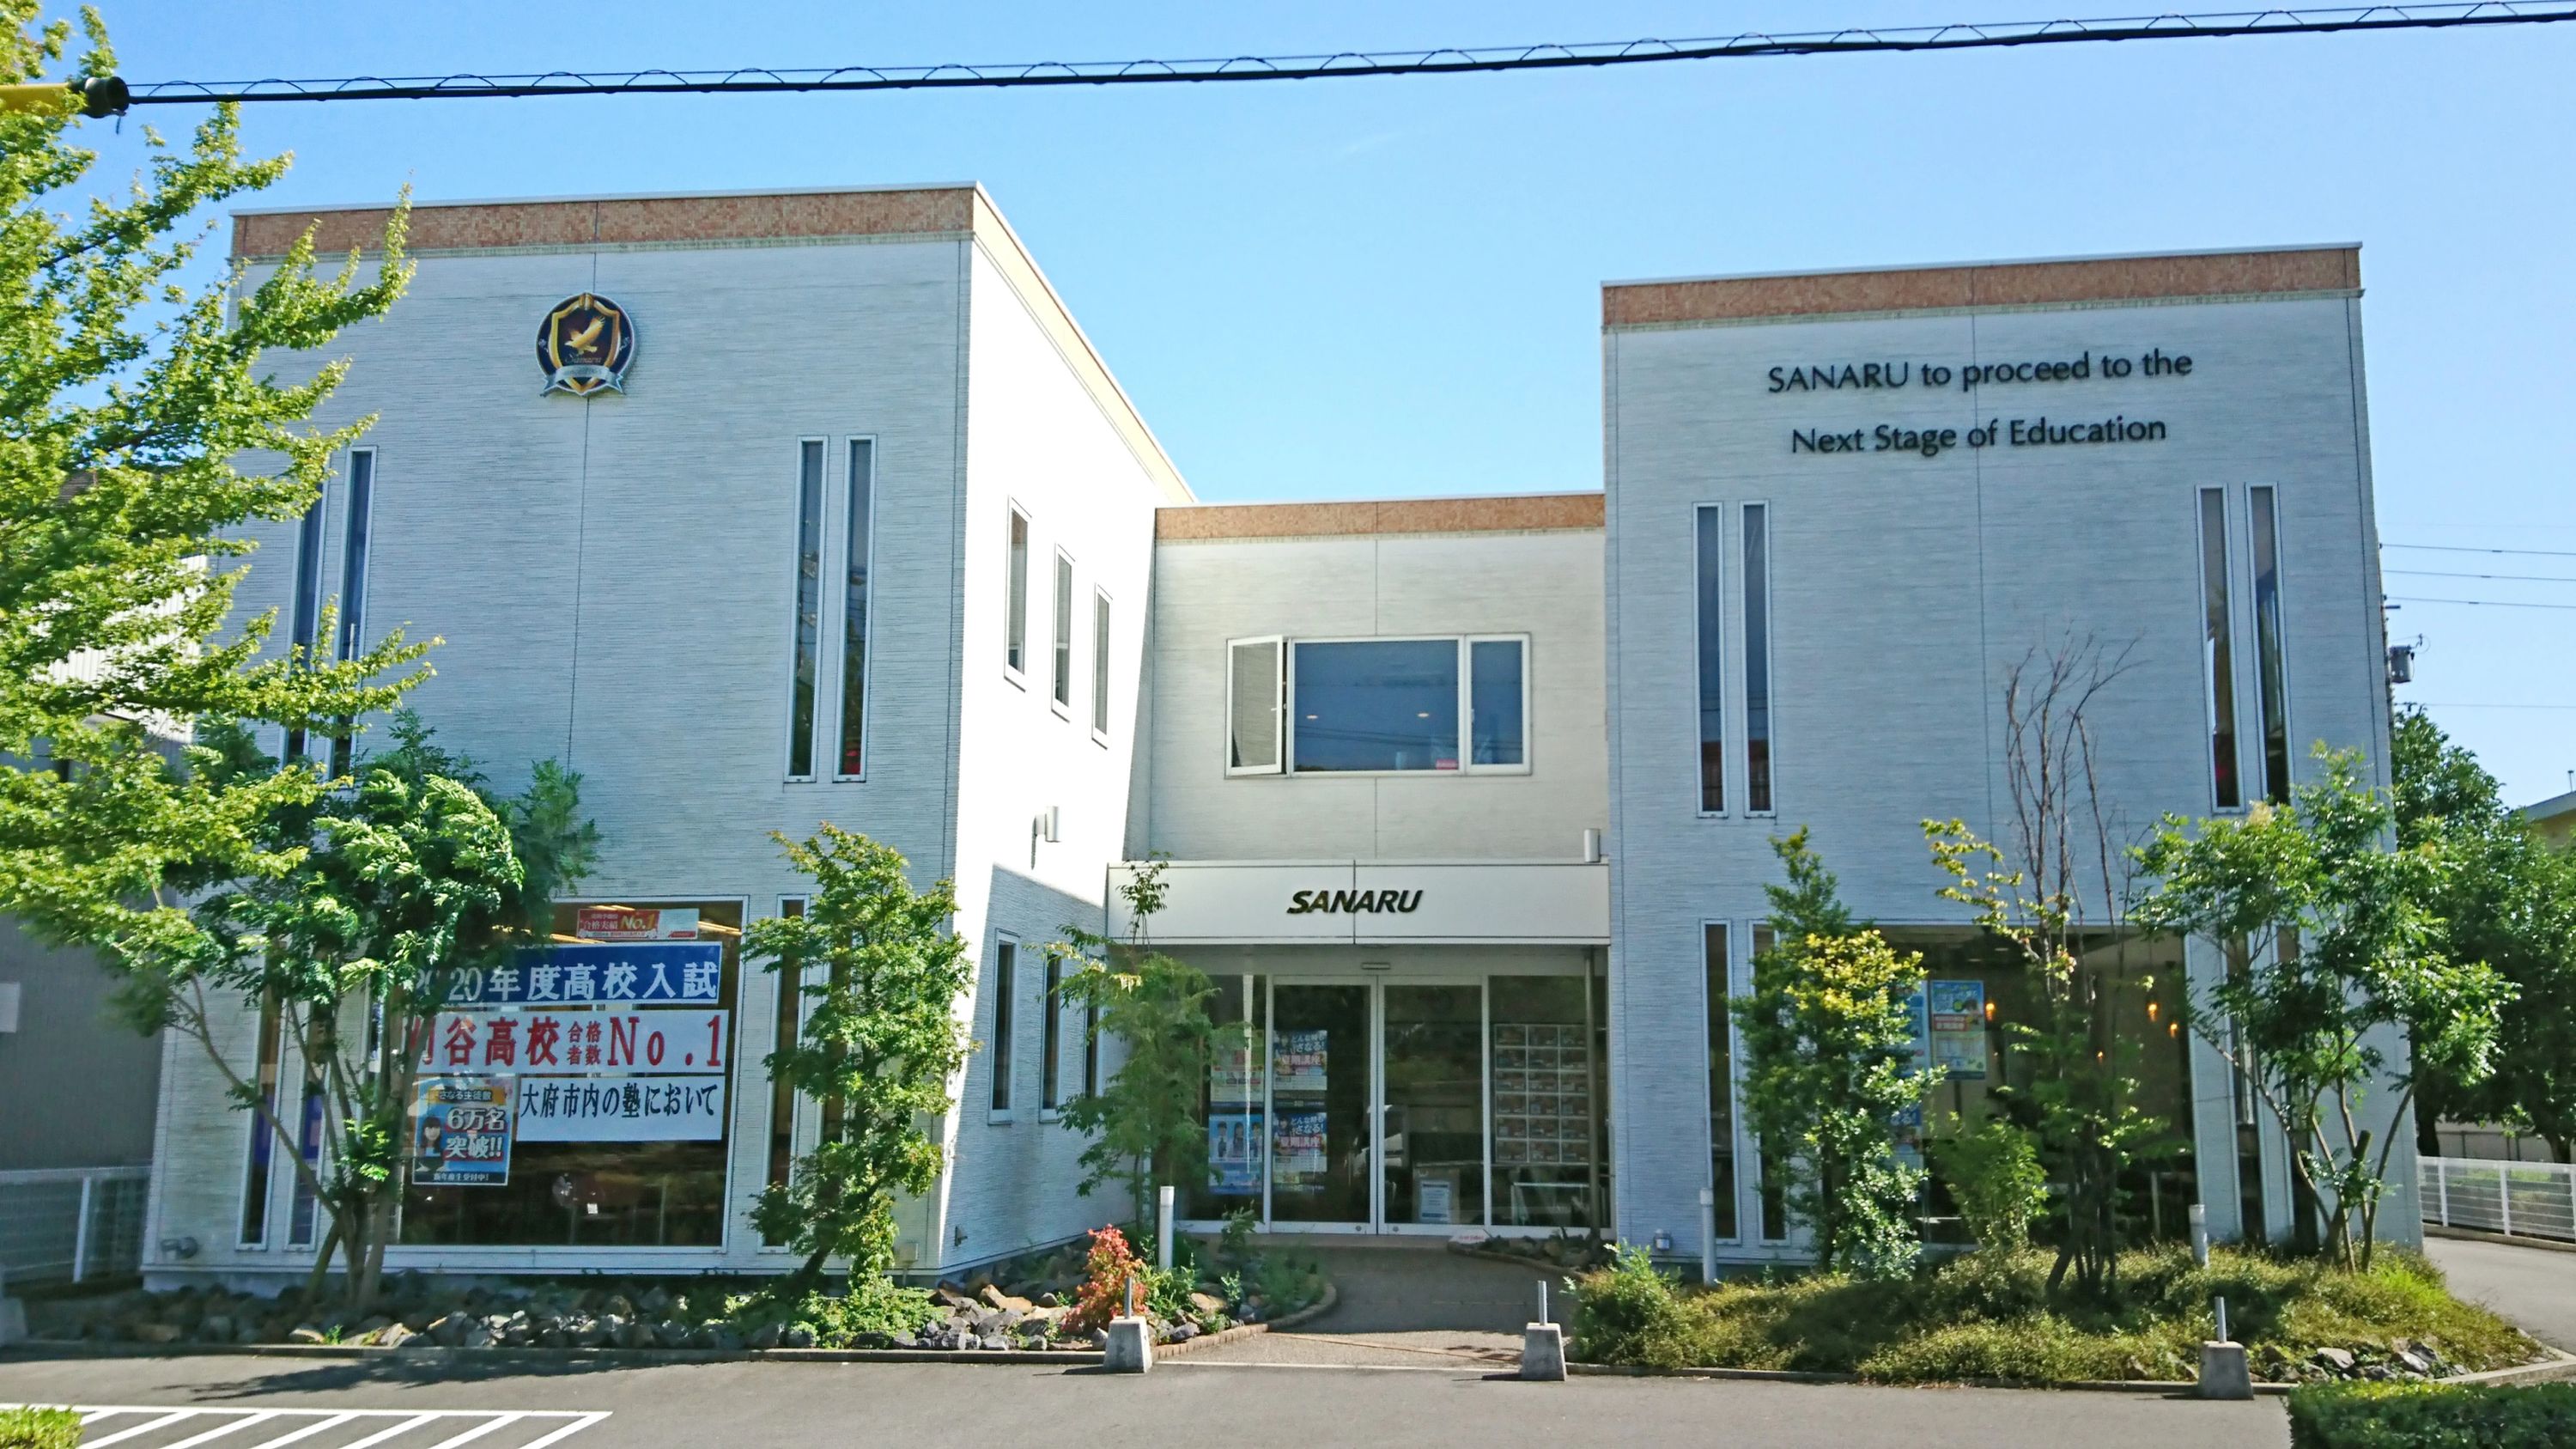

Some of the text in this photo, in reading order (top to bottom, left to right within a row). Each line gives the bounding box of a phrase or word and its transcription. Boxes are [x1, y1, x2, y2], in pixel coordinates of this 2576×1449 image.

[1768, 347, 2193, 393] SANARU to proceed to the
[1792, 415, 2166, 457] Next Stage of Education
[1286, 889, 1423, 914] SANARU
[520, 1082, 718, 1118] 大府市内の塾において
[447, 1107, 505, 1131] 6万名
[446, 1135, 503, 1160] 突破!!
